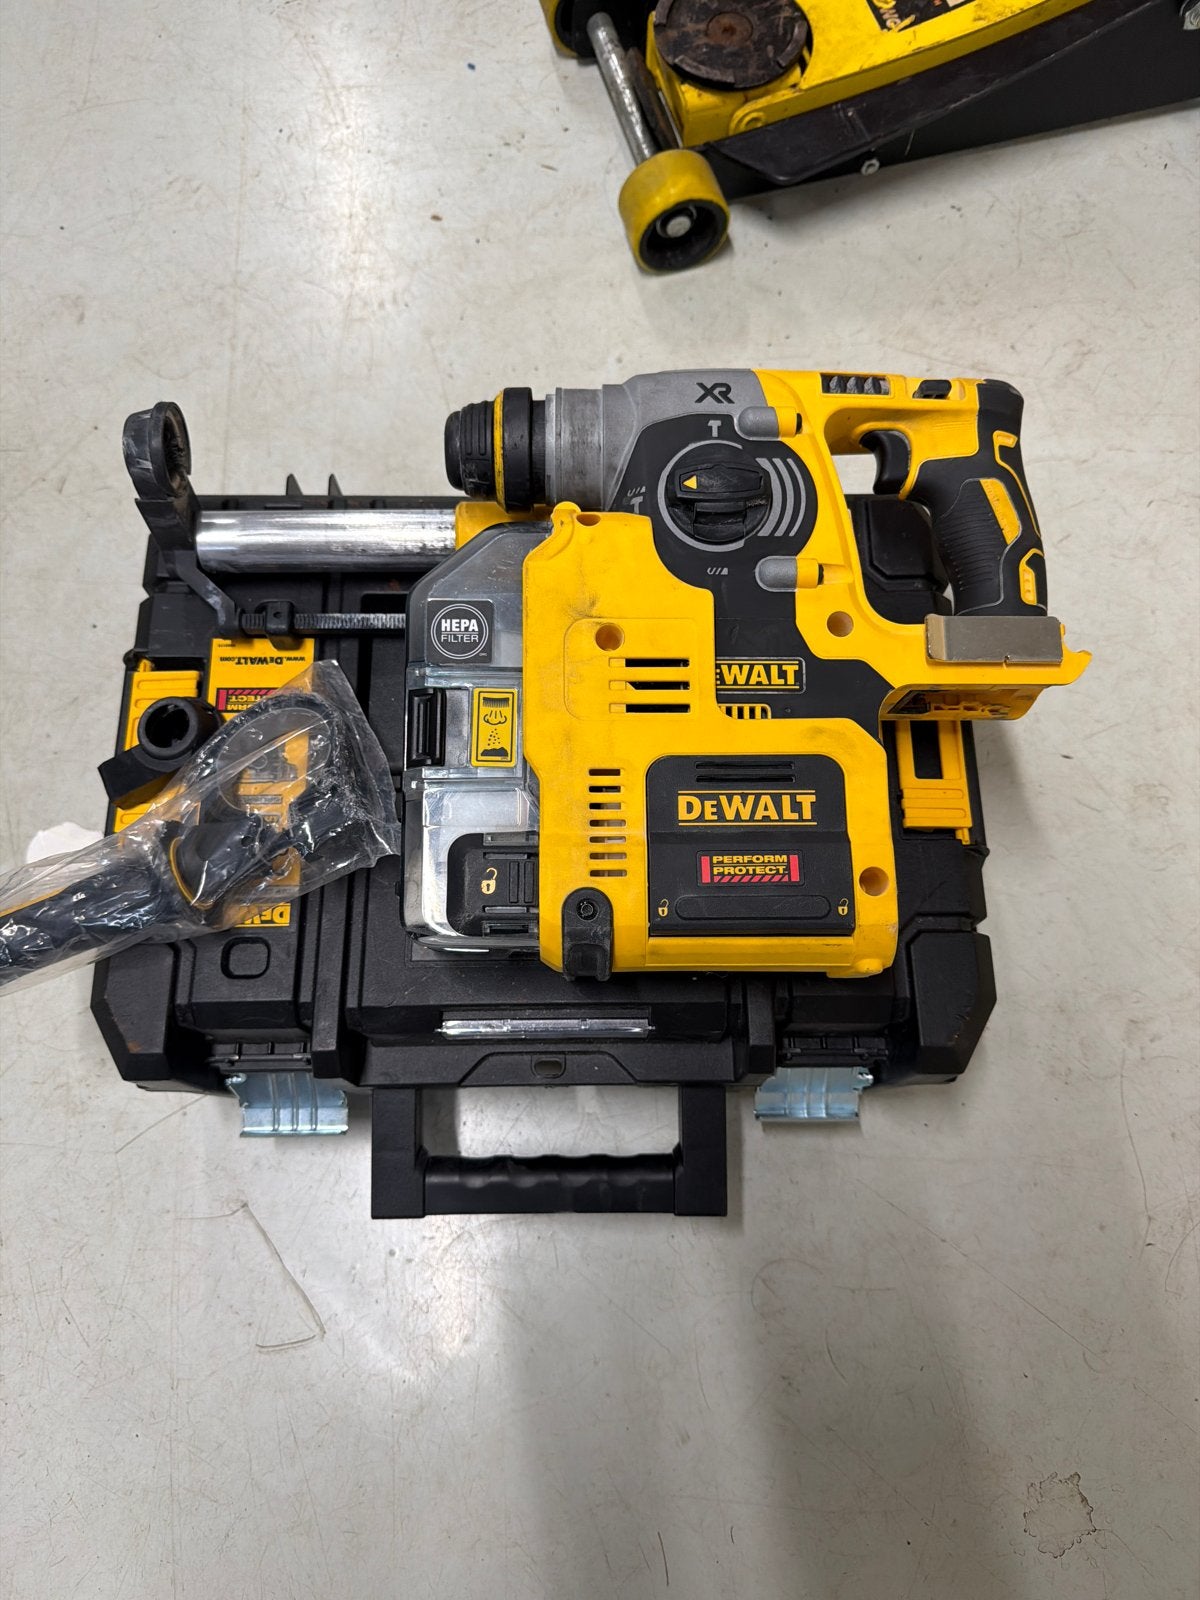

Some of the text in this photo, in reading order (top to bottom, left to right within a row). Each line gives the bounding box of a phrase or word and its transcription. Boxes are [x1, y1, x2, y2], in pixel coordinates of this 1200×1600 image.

[694, 382, 736, 405] XR
[441, 618, 479, 632] HEPA
[440, 634, 479, 643] FILTER
[712, 854, 788, 864] PERFORM
